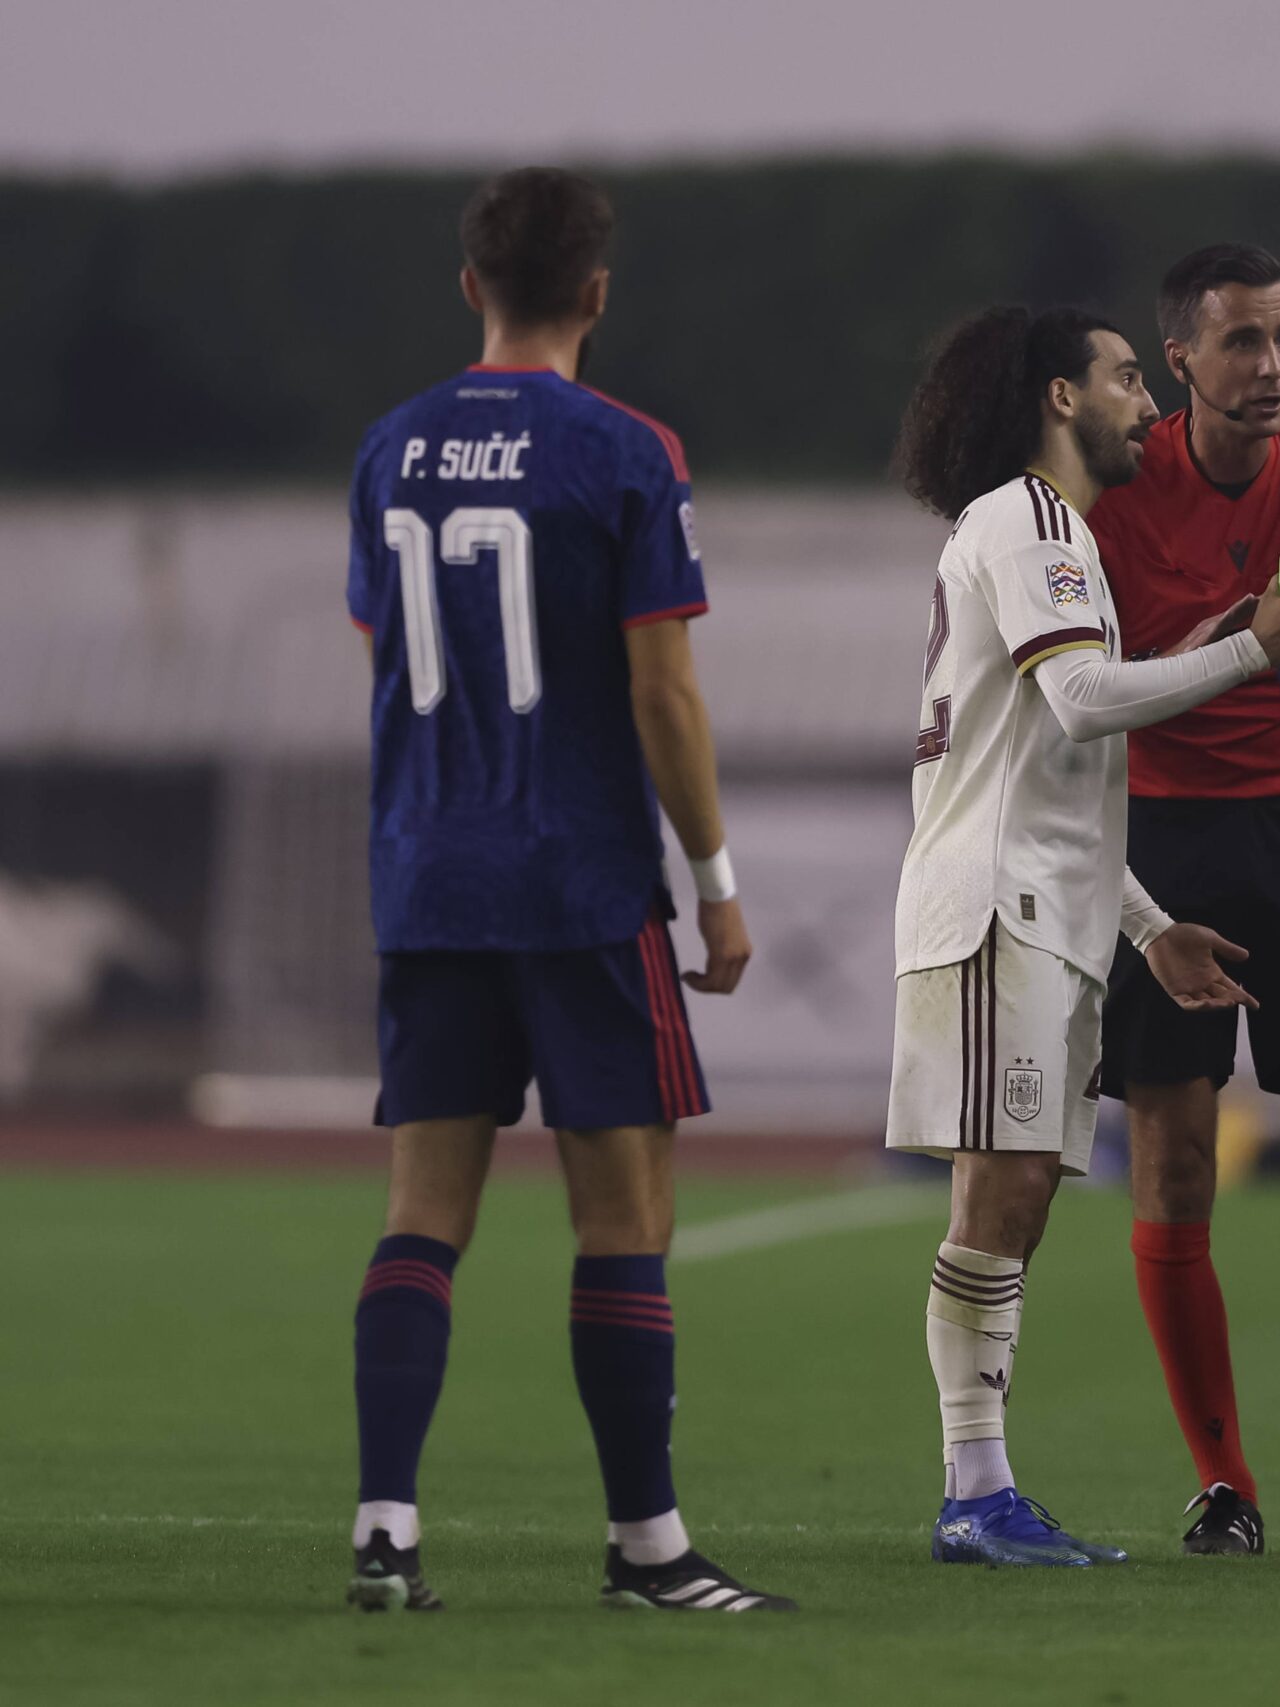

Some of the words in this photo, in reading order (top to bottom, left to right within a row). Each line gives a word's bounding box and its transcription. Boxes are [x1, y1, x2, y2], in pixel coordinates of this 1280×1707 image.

[401, 437, 427, 479] P.
[438, 430, 531, 480] SUČIĆ
[384, 507, 542, 715] 17
